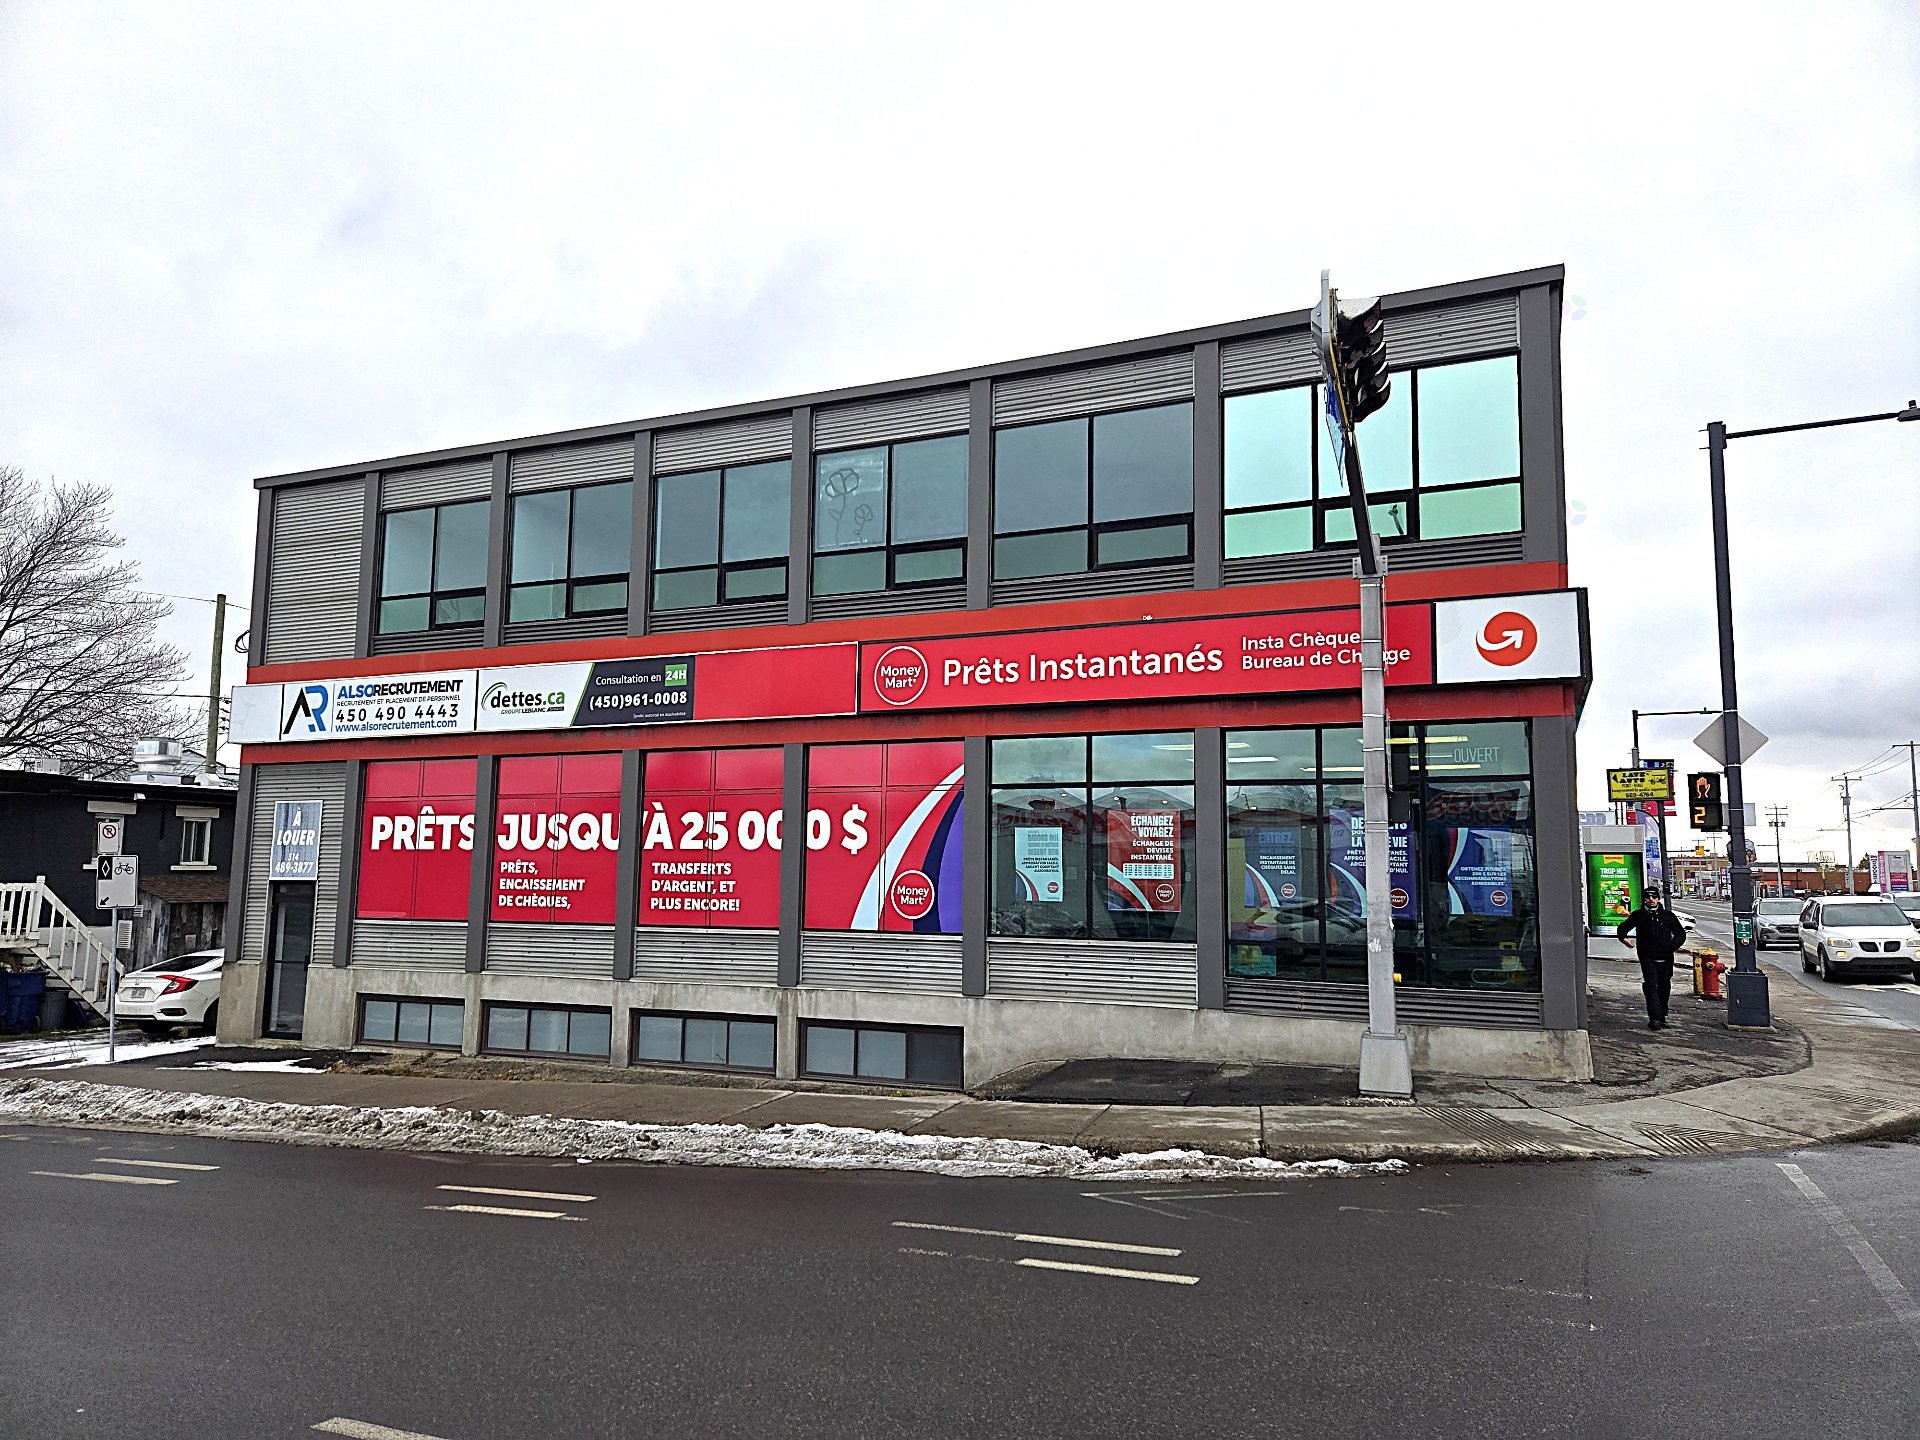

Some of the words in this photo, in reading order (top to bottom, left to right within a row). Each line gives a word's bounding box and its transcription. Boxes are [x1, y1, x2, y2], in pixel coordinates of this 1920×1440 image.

[1242, 634, 1284, 651] Insta
[943, 658, 1020, 686] Prêts
[1029, 643, 1223, 682] Instantanés
[1242, 653, 1306, 670] Bureau
[1309, 651, 1331, 667] de
[1337, 648, 1411, 668] Chge
[595, 673, 649, 686] Consultation
[650, 674, 662, 683] en
[665, 669, 687, 681] 24H
[880, 664, 922, 680] Money
[337, 679, 464, 700] ALSORECRUTEMENT
[885, 676, 914, 689] Mart
[337, 699, 376, 707] RECRUTEMENT
[386, 697, 418, 705] PLACEMENT
[426, 694, 461, 702] PERSONNEL
[490, 690, 566, 709] dettes.ca
[589, 691, 688, 711] (450)961-0008
[336, 708, 367, 723] 450
[375, 706, 406, 721] 490
[414, 703, 459, 719] 4443
[335, 718, 458, 733] www.alsorecrutement.com
[1453, 746, 1501, 763] OUVERT
[292, 807, 302, 827] À
[1130, 812, 1174, 826] ÉCHANGEZ
[1693, 806, 1707, 825] 2
[371, 805, 476, 851] PRÊTS
[679, 810, 729, 851] 25
[840, 803, 869, 855] $
[1137, 826, 1174, 838] VOYAGEZ
[276, 829, 316, 846] LOUER
[1132, 839, 1164, 847] ÉCHANGE
[1392, 836, 1408, 848] VIE
[287, 853, 300, 862] 514
[274, 861, 314, 875] 489-3877
[500, 858, 539, 875] PRÊTS,
[652, 862, 732, 875] TRANSFERTS
[499, 878, 586, 891] ENCAISSEMENT
[651, 879, 717, 894] D'ARGENT,
[719, 880, 736, 893] ET
[897, 885, 930, 898] Money
[498, 895, 513, 907] DE
[515, 892, 571, 910] CHÈQUES,
[650, 897, 682, 910] PLUS
[683, 898, 740, 911] ENCORE!
[900, 894, 923, 906] Mart
